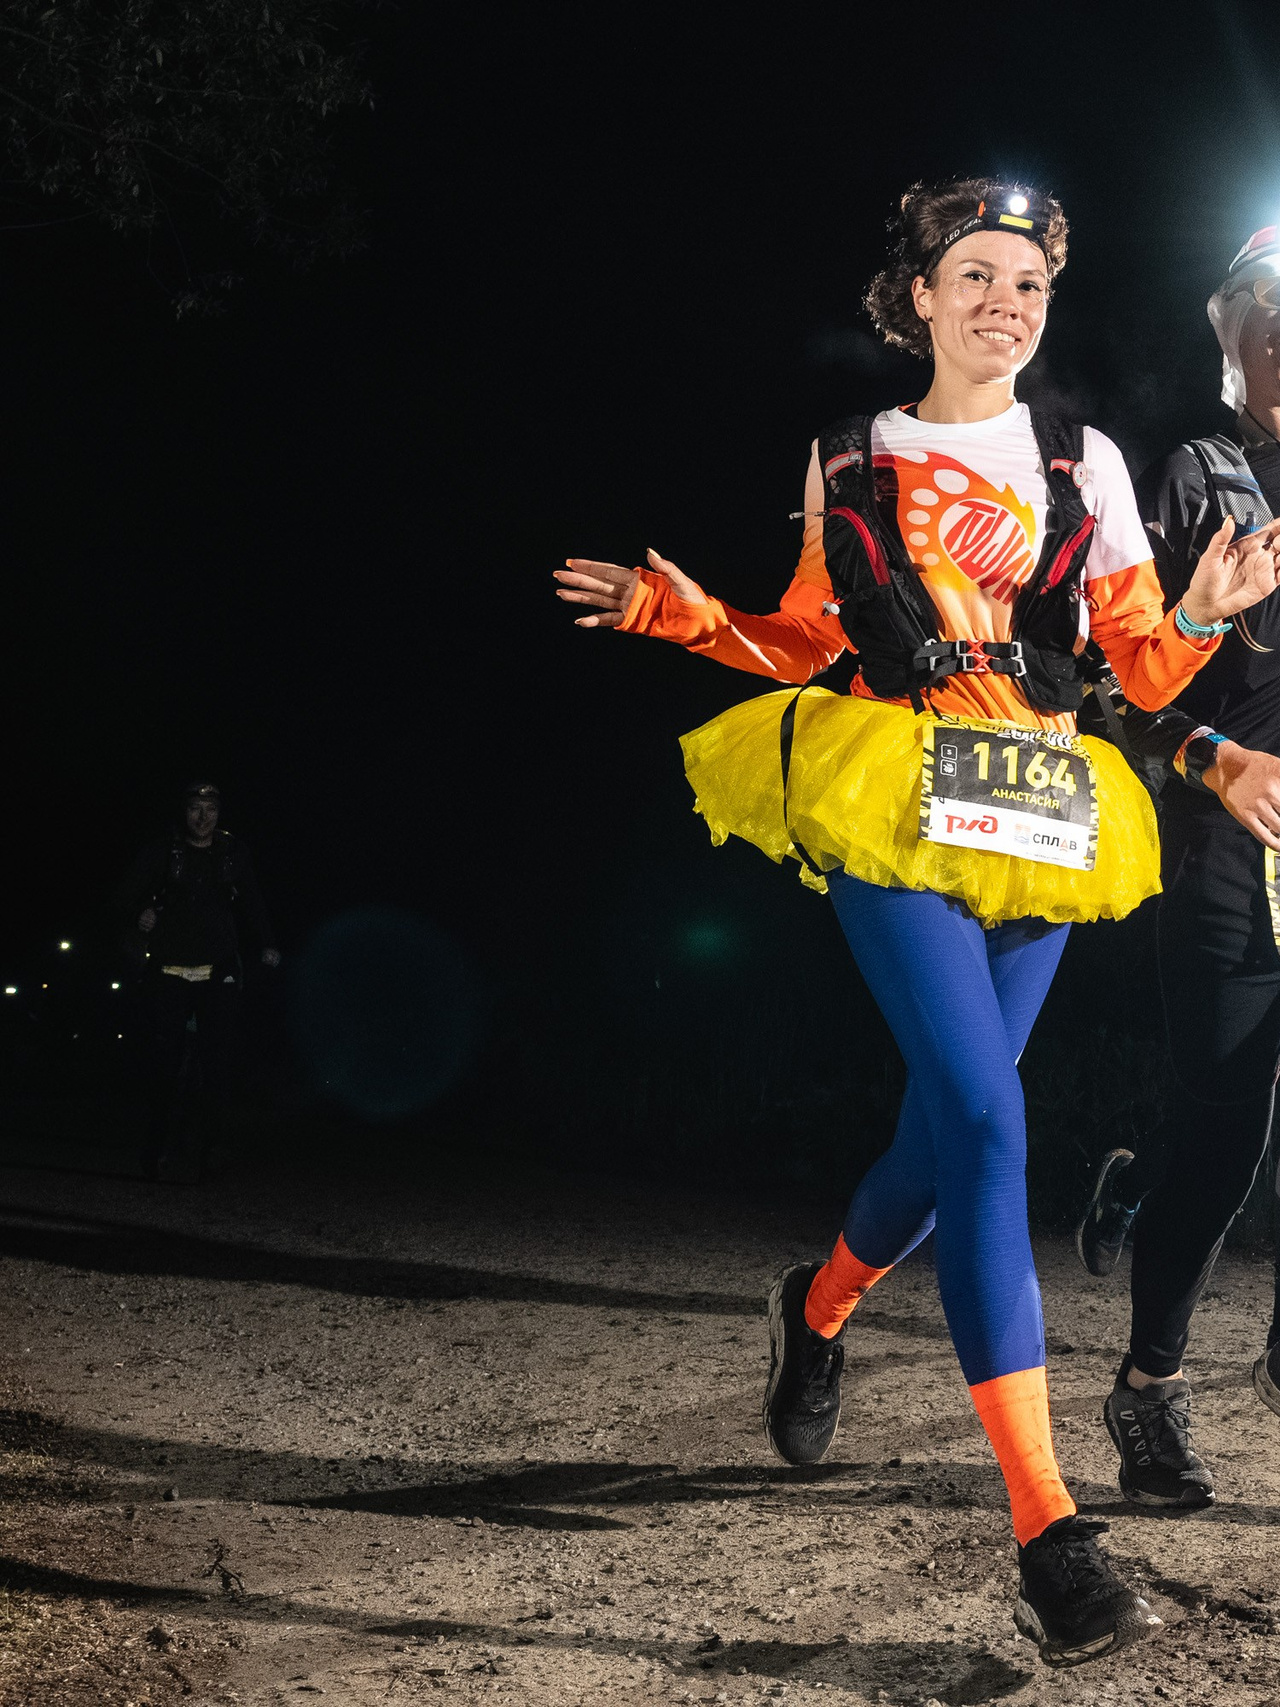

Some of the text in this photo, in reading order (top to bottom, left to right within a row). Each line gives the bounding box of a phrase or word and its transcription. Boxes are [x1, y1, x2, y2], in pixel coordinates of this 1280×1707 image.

[945, 229, 960, 245] LED
[973, 742, 1077, 796] 1164
[991, 788, 1060, 809] АНАСТАСИЯ
[1033, 833, 1078, 852] СПЛАВ
